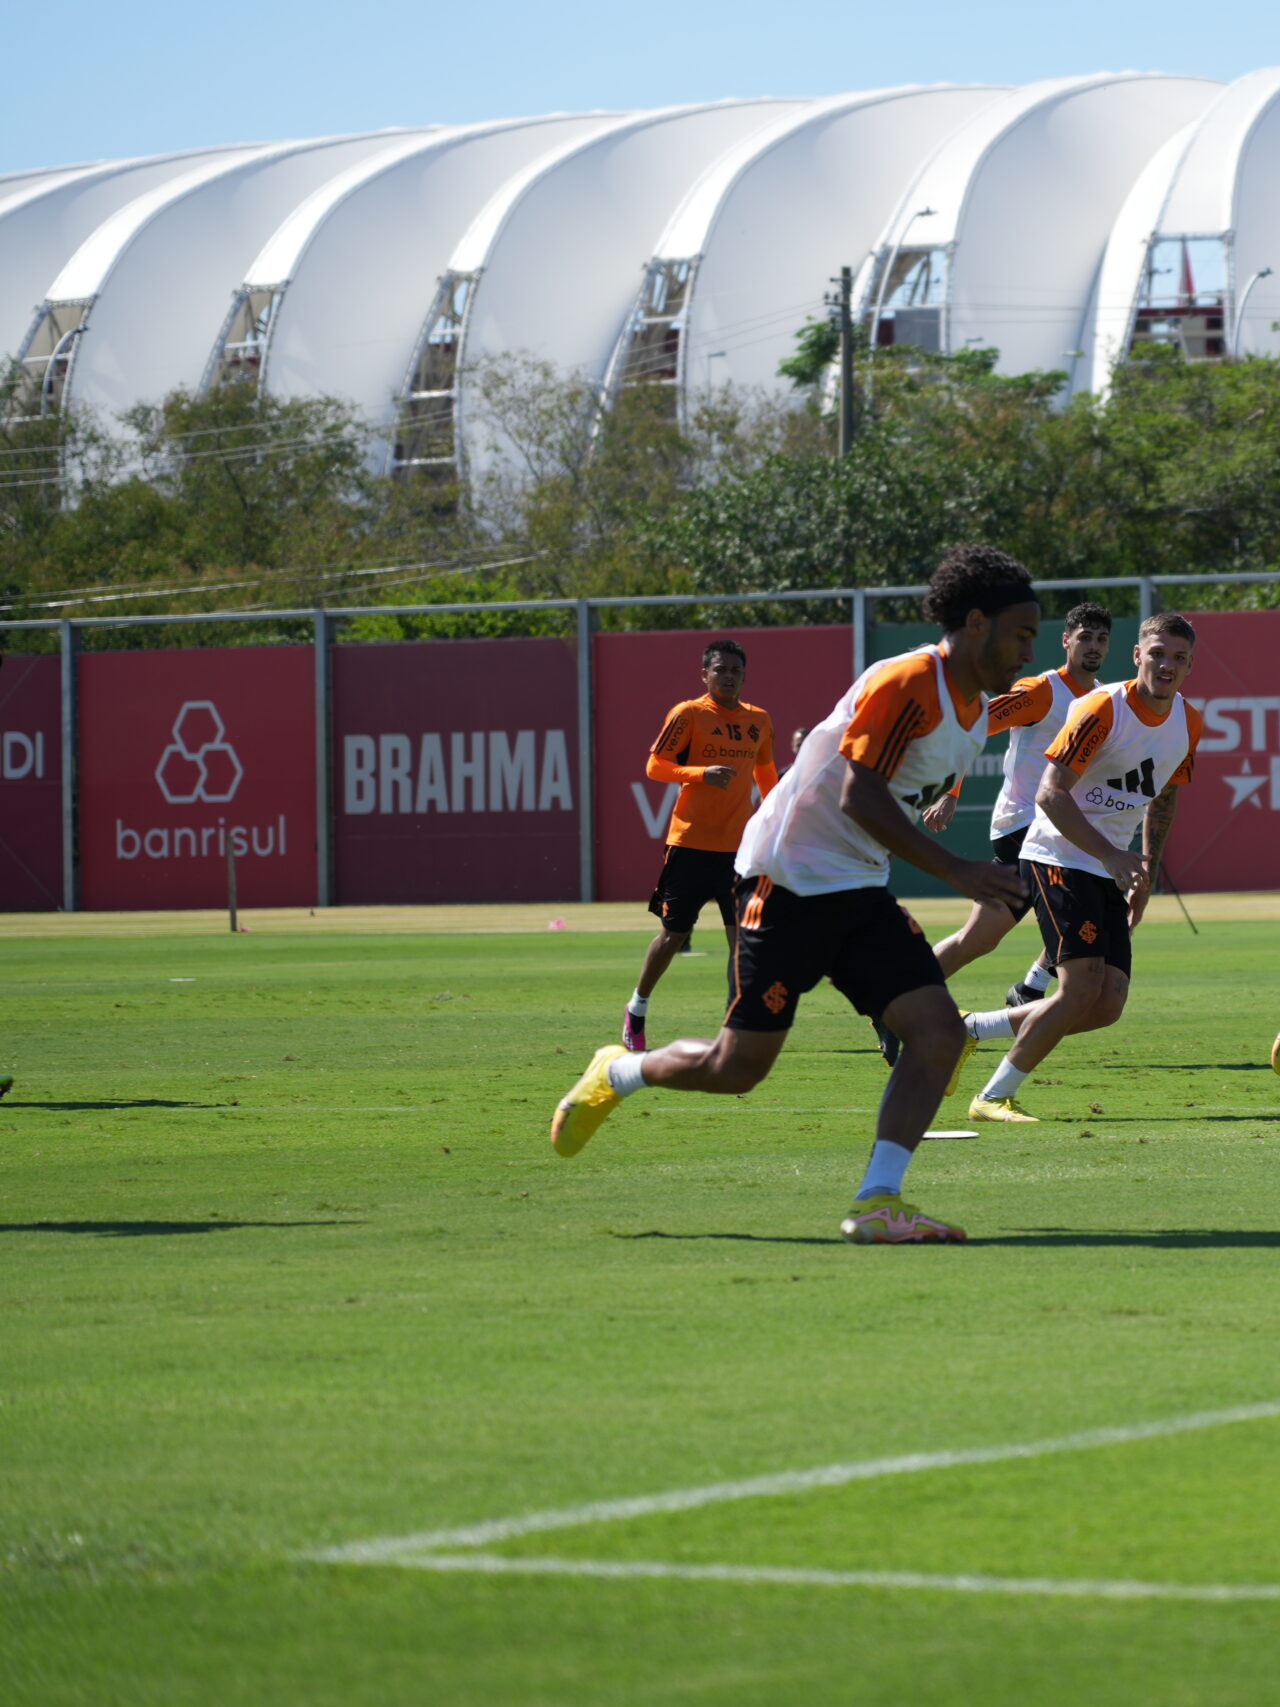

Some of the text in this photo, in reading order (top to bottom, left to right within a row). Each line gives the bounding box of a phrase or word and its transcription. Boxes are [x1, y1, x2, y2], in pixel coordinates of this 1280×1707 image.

[994, 701, 1022, 721] vero
[666, 726, 685, 752] vero
[725, 723, 742, 741] 15
[1077, 734, 1100, 763] vero
[344, 729, 574, 815] BRAHMA
[115, 815, 286, 859] banrisul
